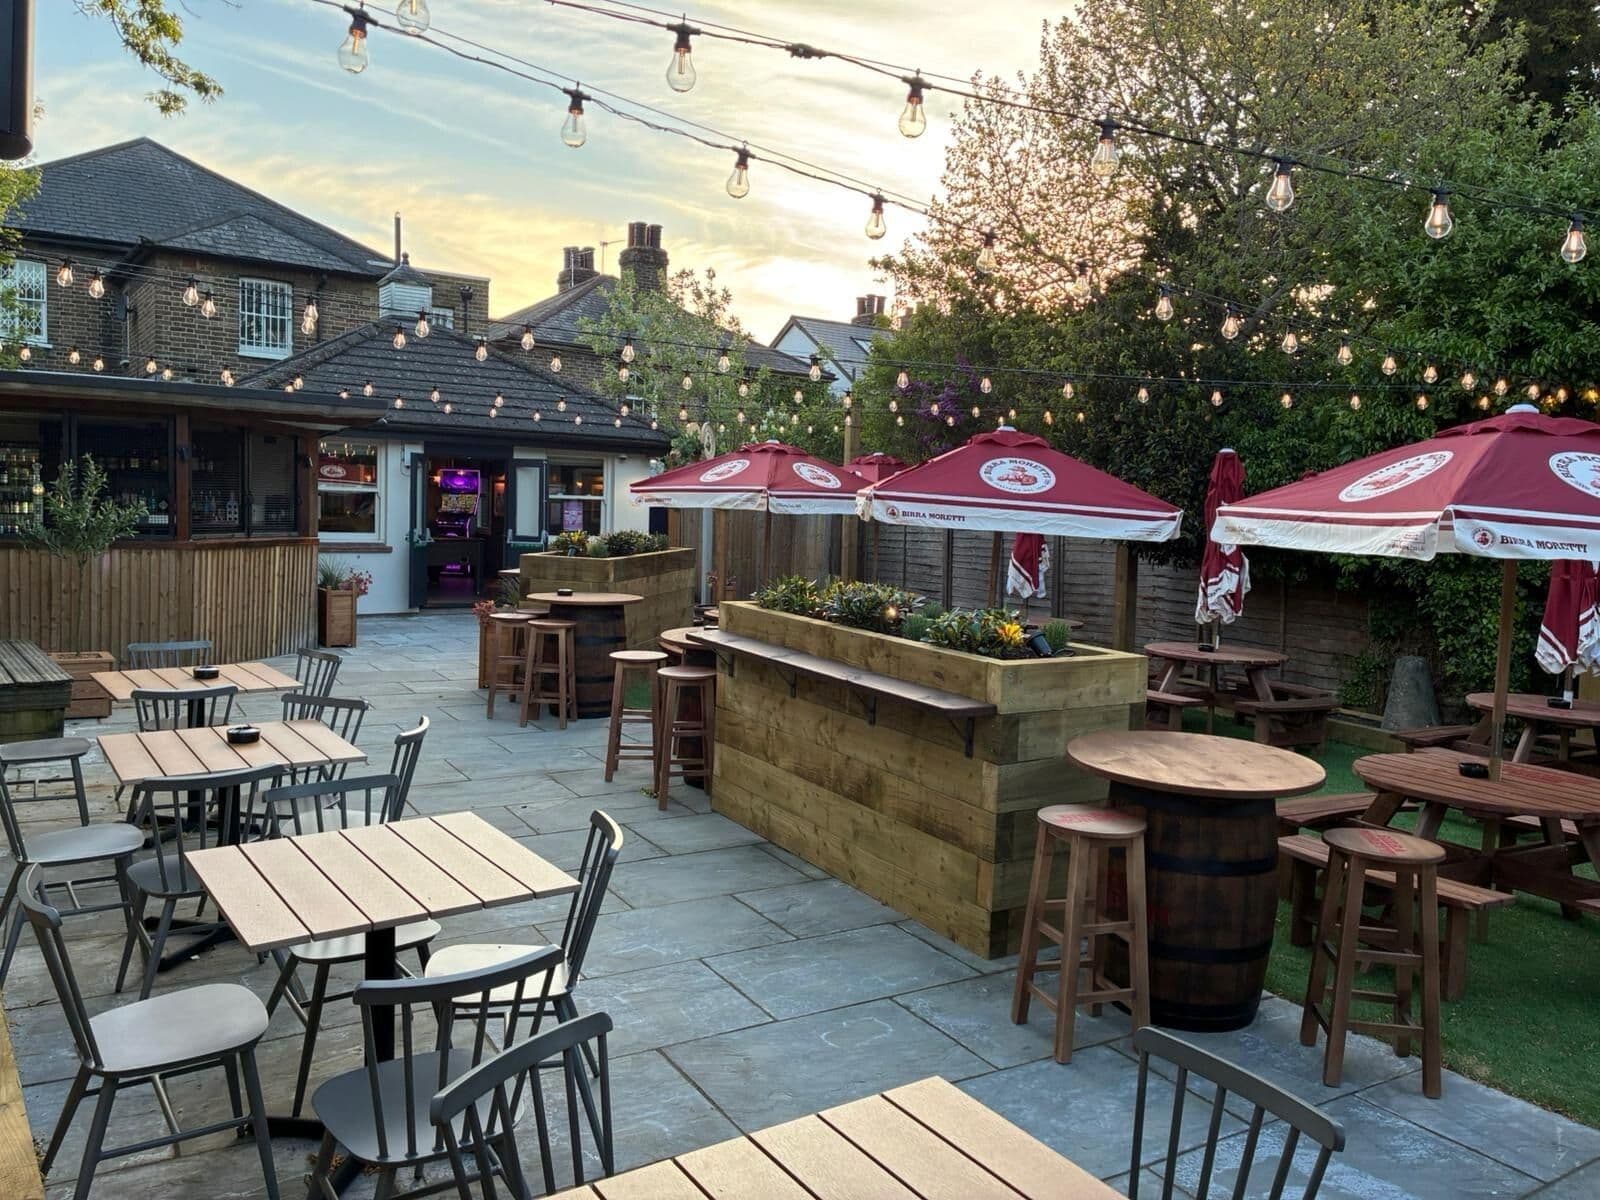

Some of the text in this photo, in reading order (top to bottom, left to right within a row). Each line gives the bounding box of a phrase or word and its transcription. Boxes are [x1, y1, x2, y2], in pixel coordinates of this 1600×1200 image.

[1556, 455, 1577, 479] BIRRA
[901, 510, 965, 521] BIRRA MORETTI
[1500, 535, 1587, 553] BIRRA MORETTI
